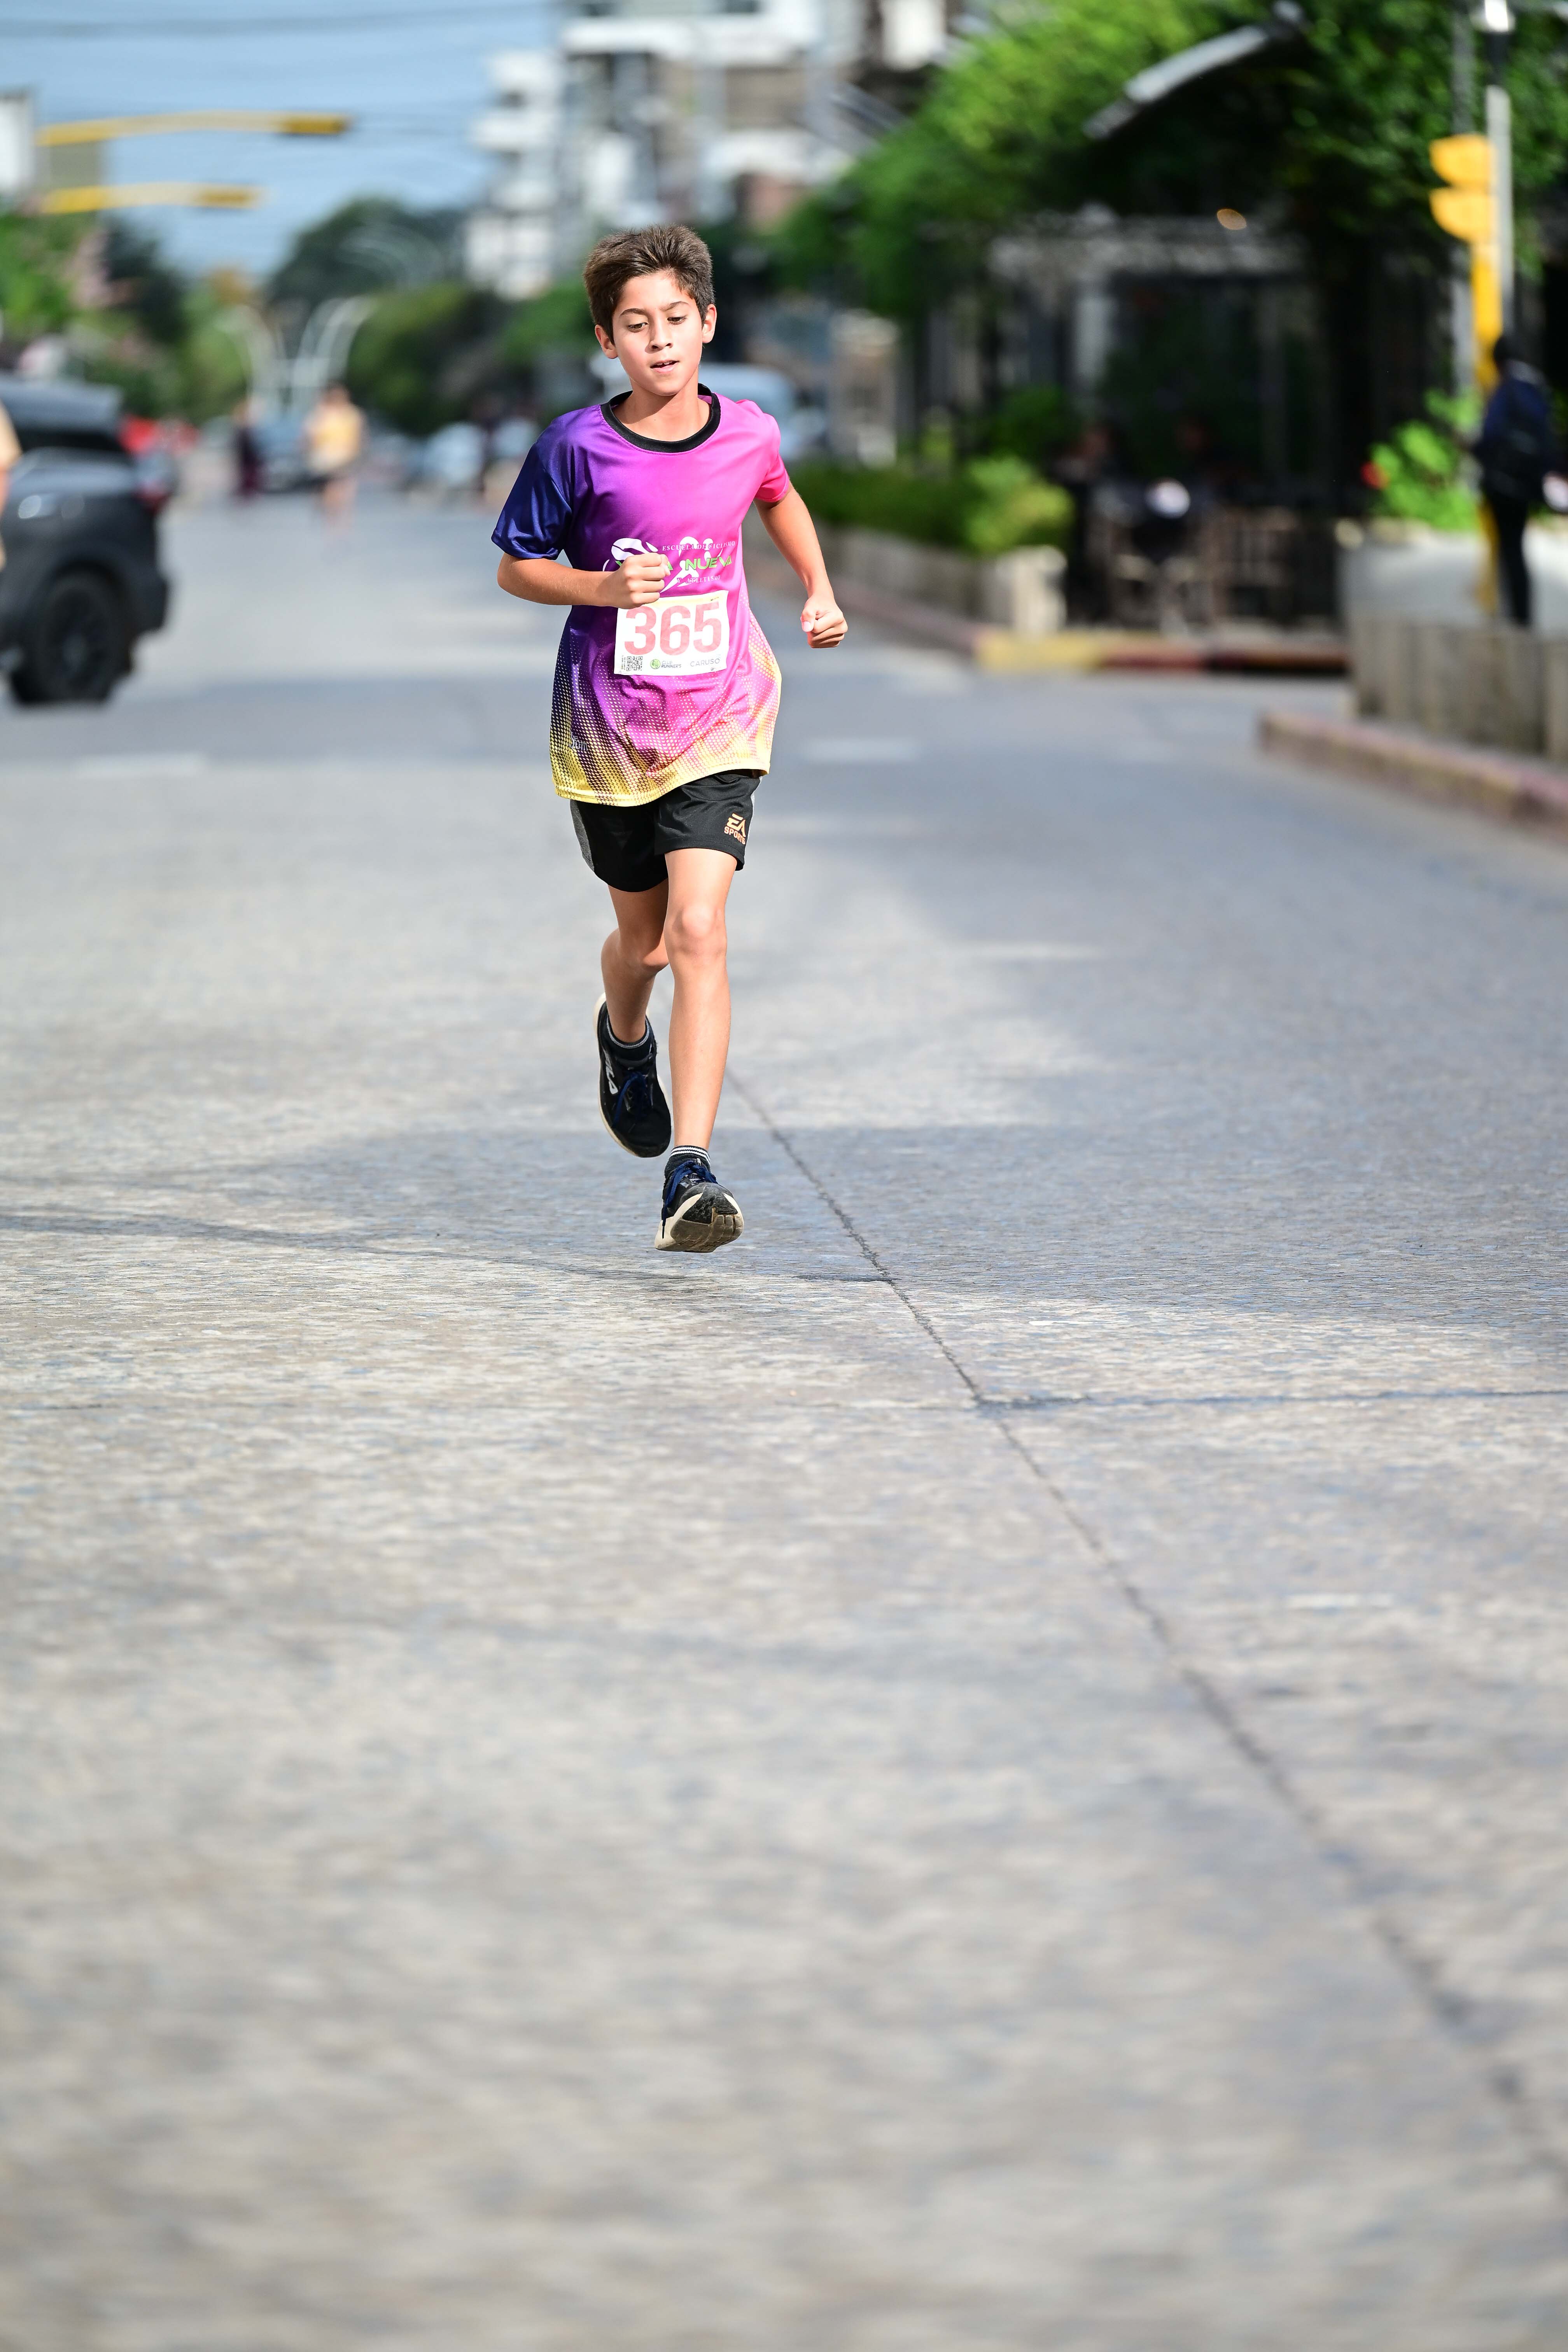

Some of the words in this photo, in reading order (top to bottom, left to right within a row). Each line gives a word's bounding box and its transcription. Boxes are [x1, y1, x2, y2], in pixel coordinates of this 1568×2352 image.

[708, 541, 735, 549] CICLISMO
[685, 555, 732, 570] NUEVA
[685, 575, 721, 583] ATLETISMO
[624, 601, 721, 656] 365
[690, 658, 720, 667] CARUSO
[726, 813, 746, 837] EA
[724, 826, 746, 845] SPORTS
